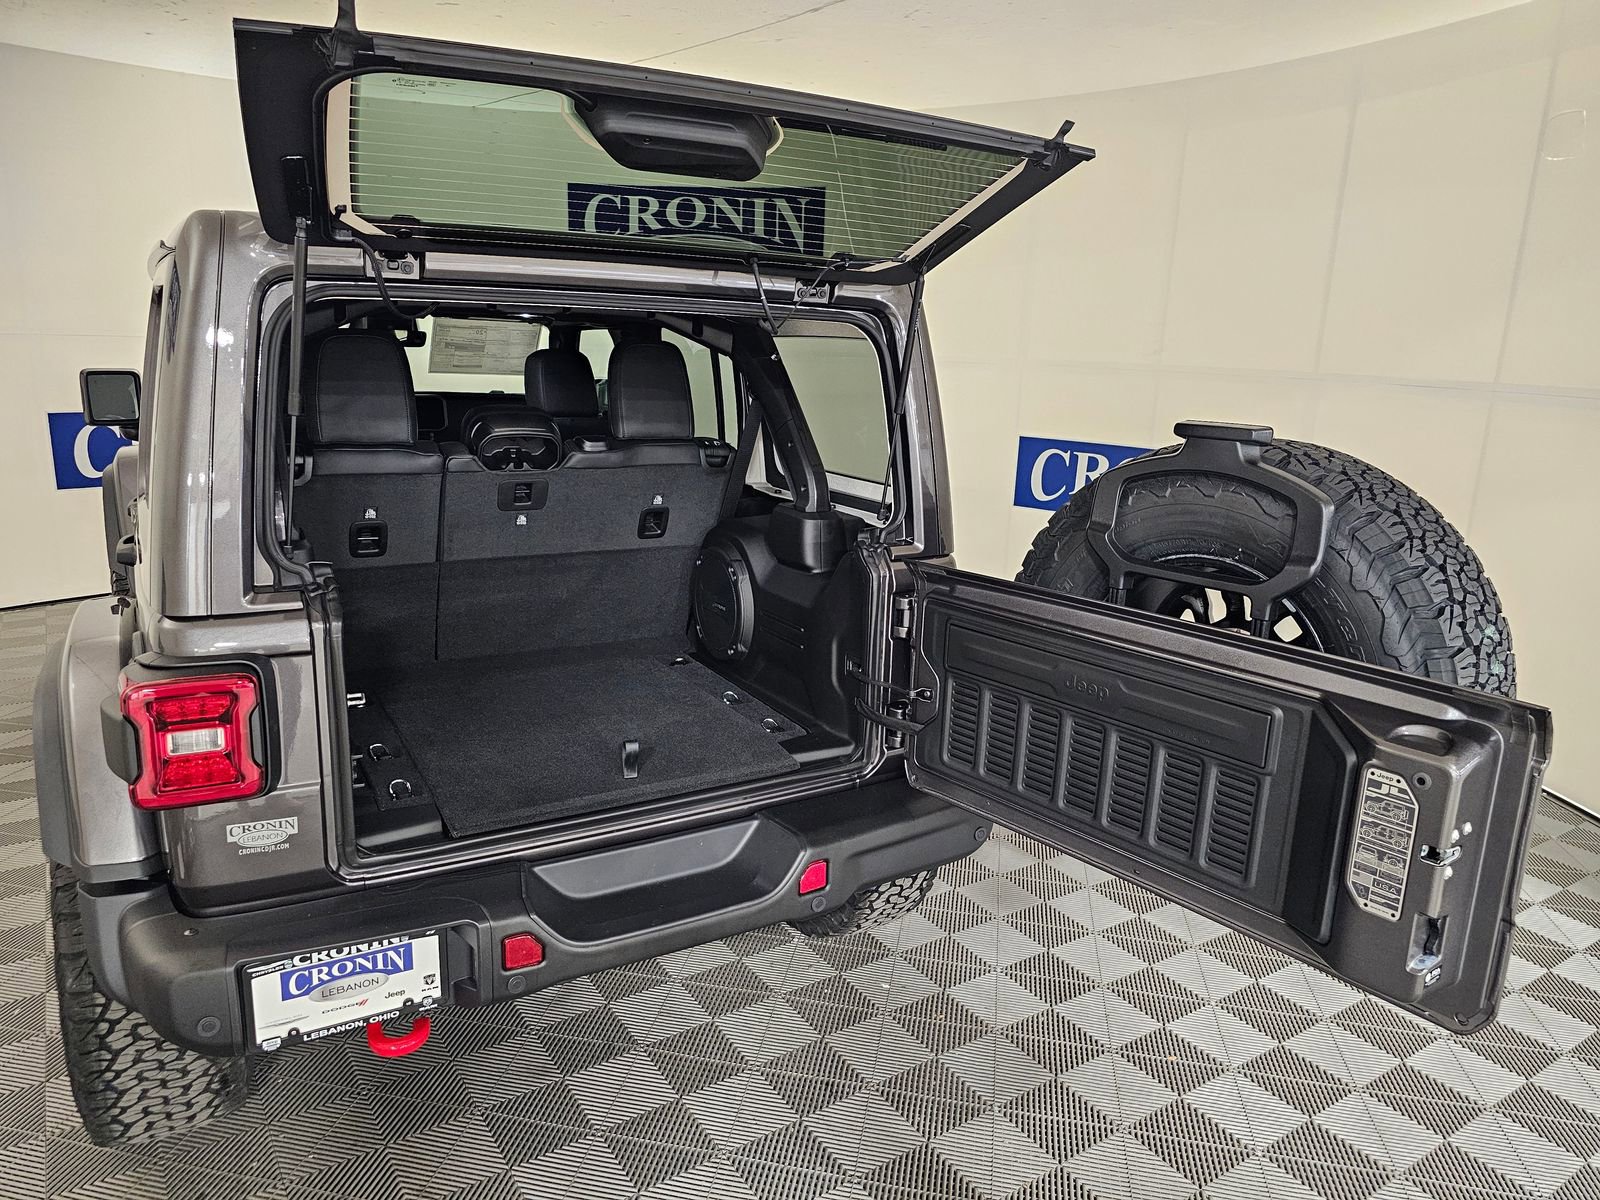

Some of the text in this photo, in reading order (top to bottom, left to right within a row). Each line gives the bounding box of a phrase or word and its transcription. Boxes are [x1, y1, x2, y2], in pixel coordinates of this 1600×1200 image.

[584, 193, 810, 254] CRONIN
[1066, 674, 1110, 702] Jeep
[1376, 773, 1394, 782] Jeep
[1368, 783, 1410, 799] JL
[229, 819, 296, 838] CRONIN
[242, 833, 284, 843] LEBANON
[1374, 881, 1398, 895] USA
[288, 948, 406, 996] CRONIN
[321, 977, 380, 999] LEBANON
[384, 989, 406, 1000] Jeep
[303, 1010, 400, 1042] LEBANON, OHIO
